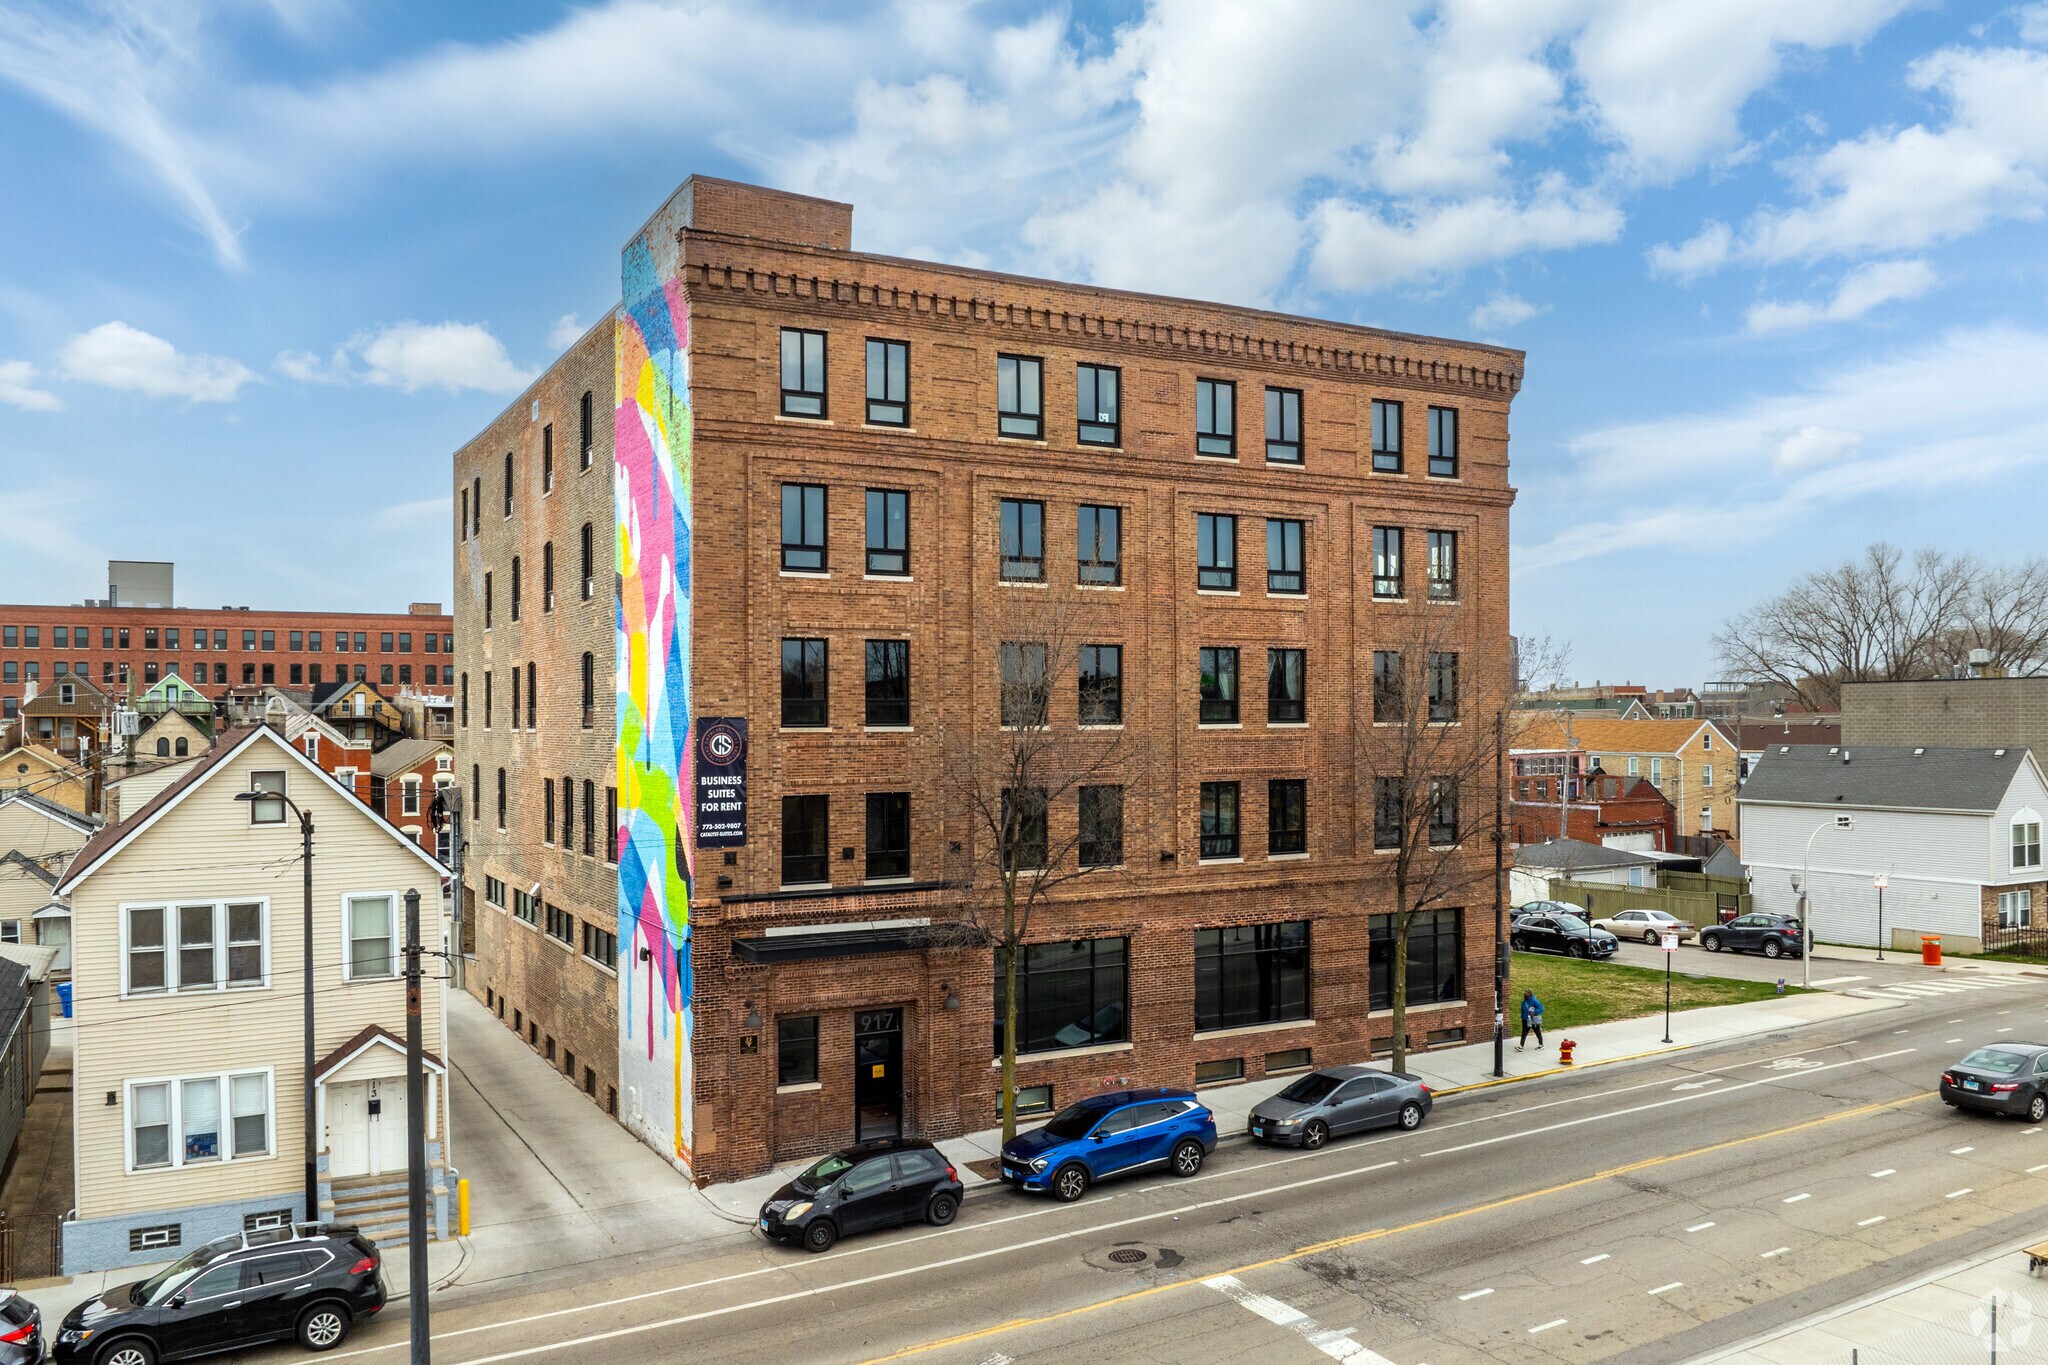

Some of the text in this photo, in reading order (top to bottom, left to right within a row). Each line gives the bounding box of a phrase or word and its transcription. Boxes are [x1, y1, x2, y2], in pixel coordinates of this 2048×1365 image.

[701, 776, 742, 785] BUSINESS
[707, 789, 736, 798] SUITES
[701, 801, 742, 812] FOR RENT
[860, 1012, 894, 1031] 917
